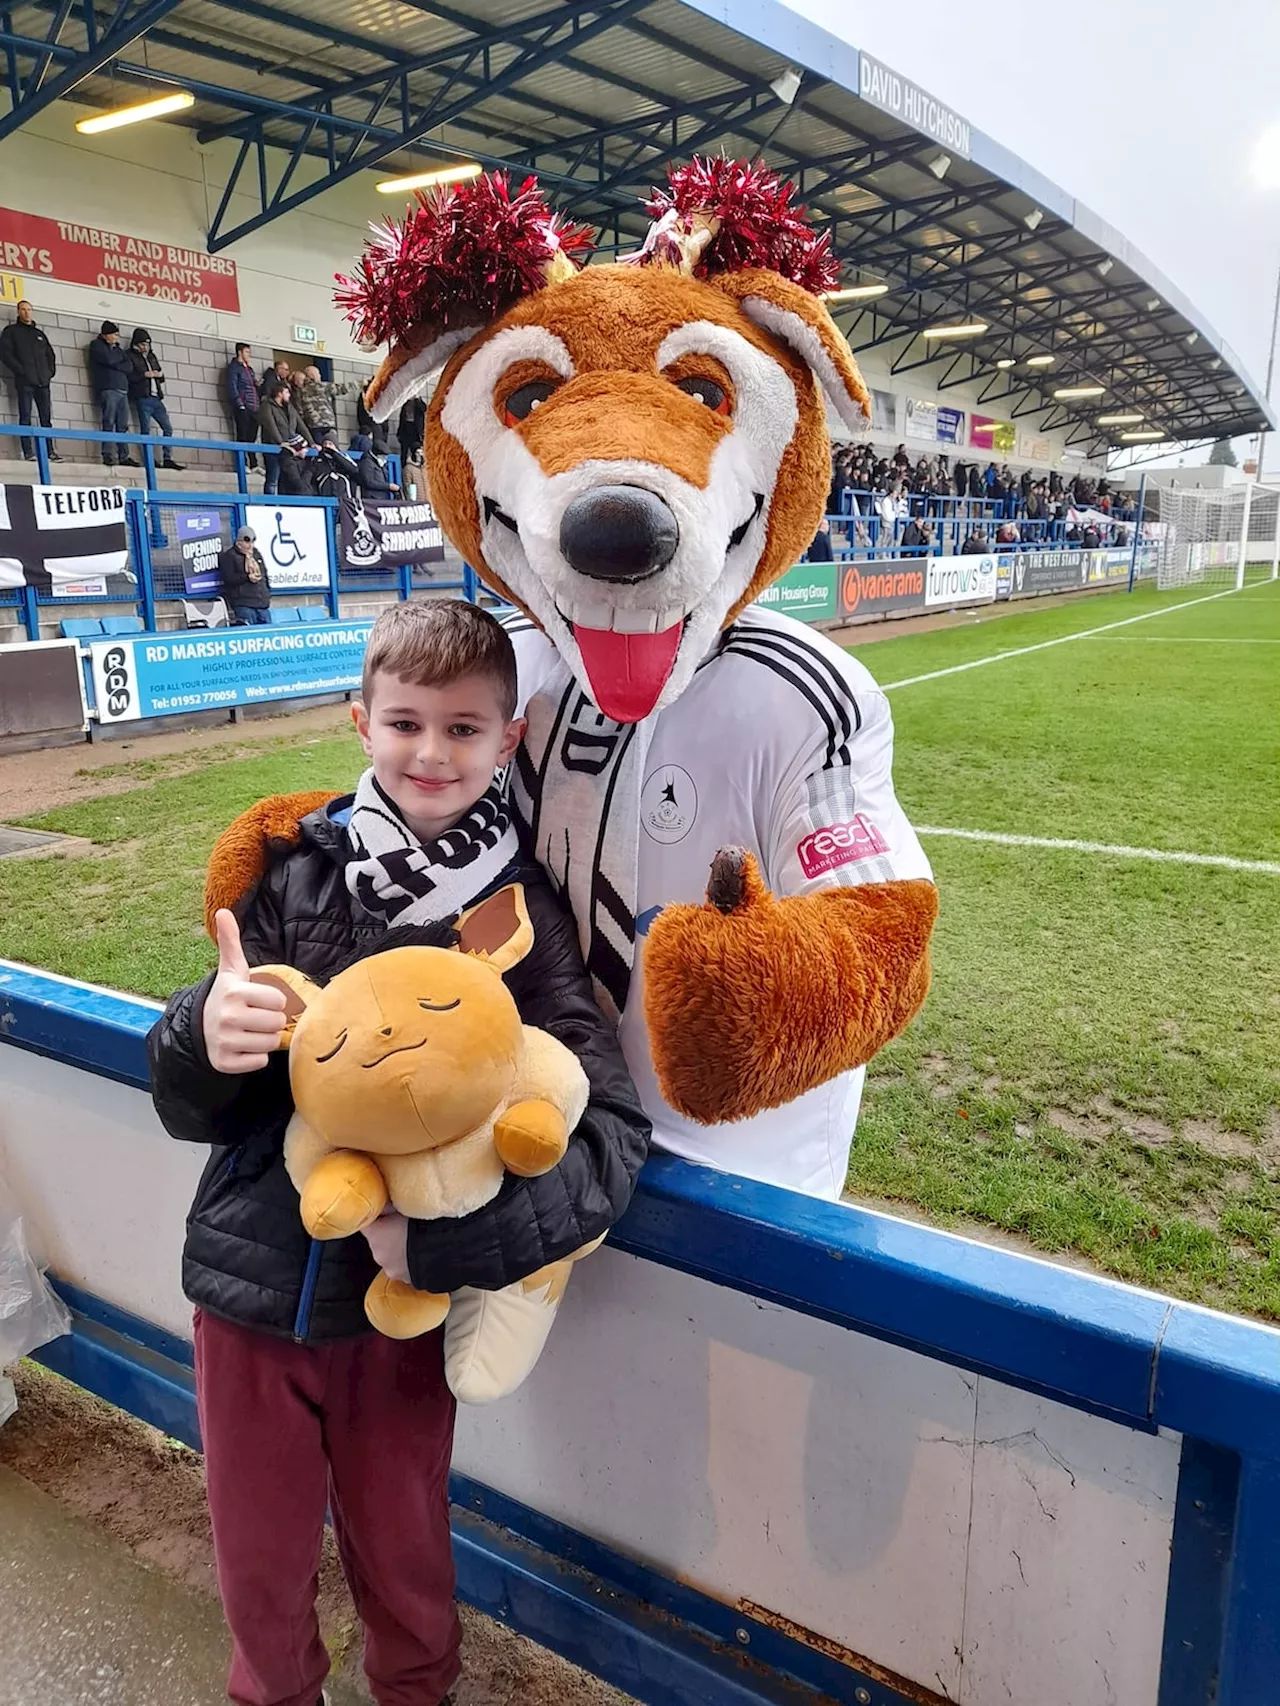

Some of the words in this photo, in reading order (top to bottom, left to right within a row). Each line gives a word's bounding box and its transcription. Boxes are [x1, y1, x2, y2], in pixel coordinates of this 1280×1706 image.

[861, 57, 901, 111] DAVID
[904, 84, 970, 153] HUTCHISON
[57, 222, 121, 252] TIMBER
[125, 238, 163, 260] AND
[166, 247, 235, 276] BUILDERS
[104, 253, 202, 287] MERCHANTS
[97, 273, 149, 296] 01952
[152, 283, 180, 301] 200
[184, 290, 212, 308] 220
[41, 488, 124, 515] TELFORD
[377, 507, 400, 526] THE
[401, 504, 431, 525] PRIDE
[182, 538, 222, 560] OPENING
[1029, 554, 1043, 568] THE
[1043, 553, 1060, 567] WEST
[1061, 552, 1080, 567] STAND
[192, 554, 219, 573] SOON
[301, 572, 323, 583] Area
[861, 571, 922, 599] vanarama
[929, 562, 978, 597] furrows
[754, 584, 780, 604] ekin
[781, 585, 808, 602] Housing
[808, 584, 829, 600] Group
[145, 646, 169, 663] RD
[171, 640, 226, 661] MARSH
[228, 634, 304, 655] SURFACING
[202, 661, 234, 673] HIGHLY
[235, 653, 294, 670] PROFESSIONAL
[295, 650, 329, 665] SURFACE
[150, 685, 165, 693] FOR
[166, 683, 180, 692] ALL
[181, 680, 200, 690] YOUR
[201, 674, 240, 688] SURFACING
[151, 698, 169, 709] Tel:
[170, 694, 201, 706] 01952
[201, 689, 237, 703] 770056
[245, 685, 269, 698] Web:
[808, 848, 858, 875] MARKETING
